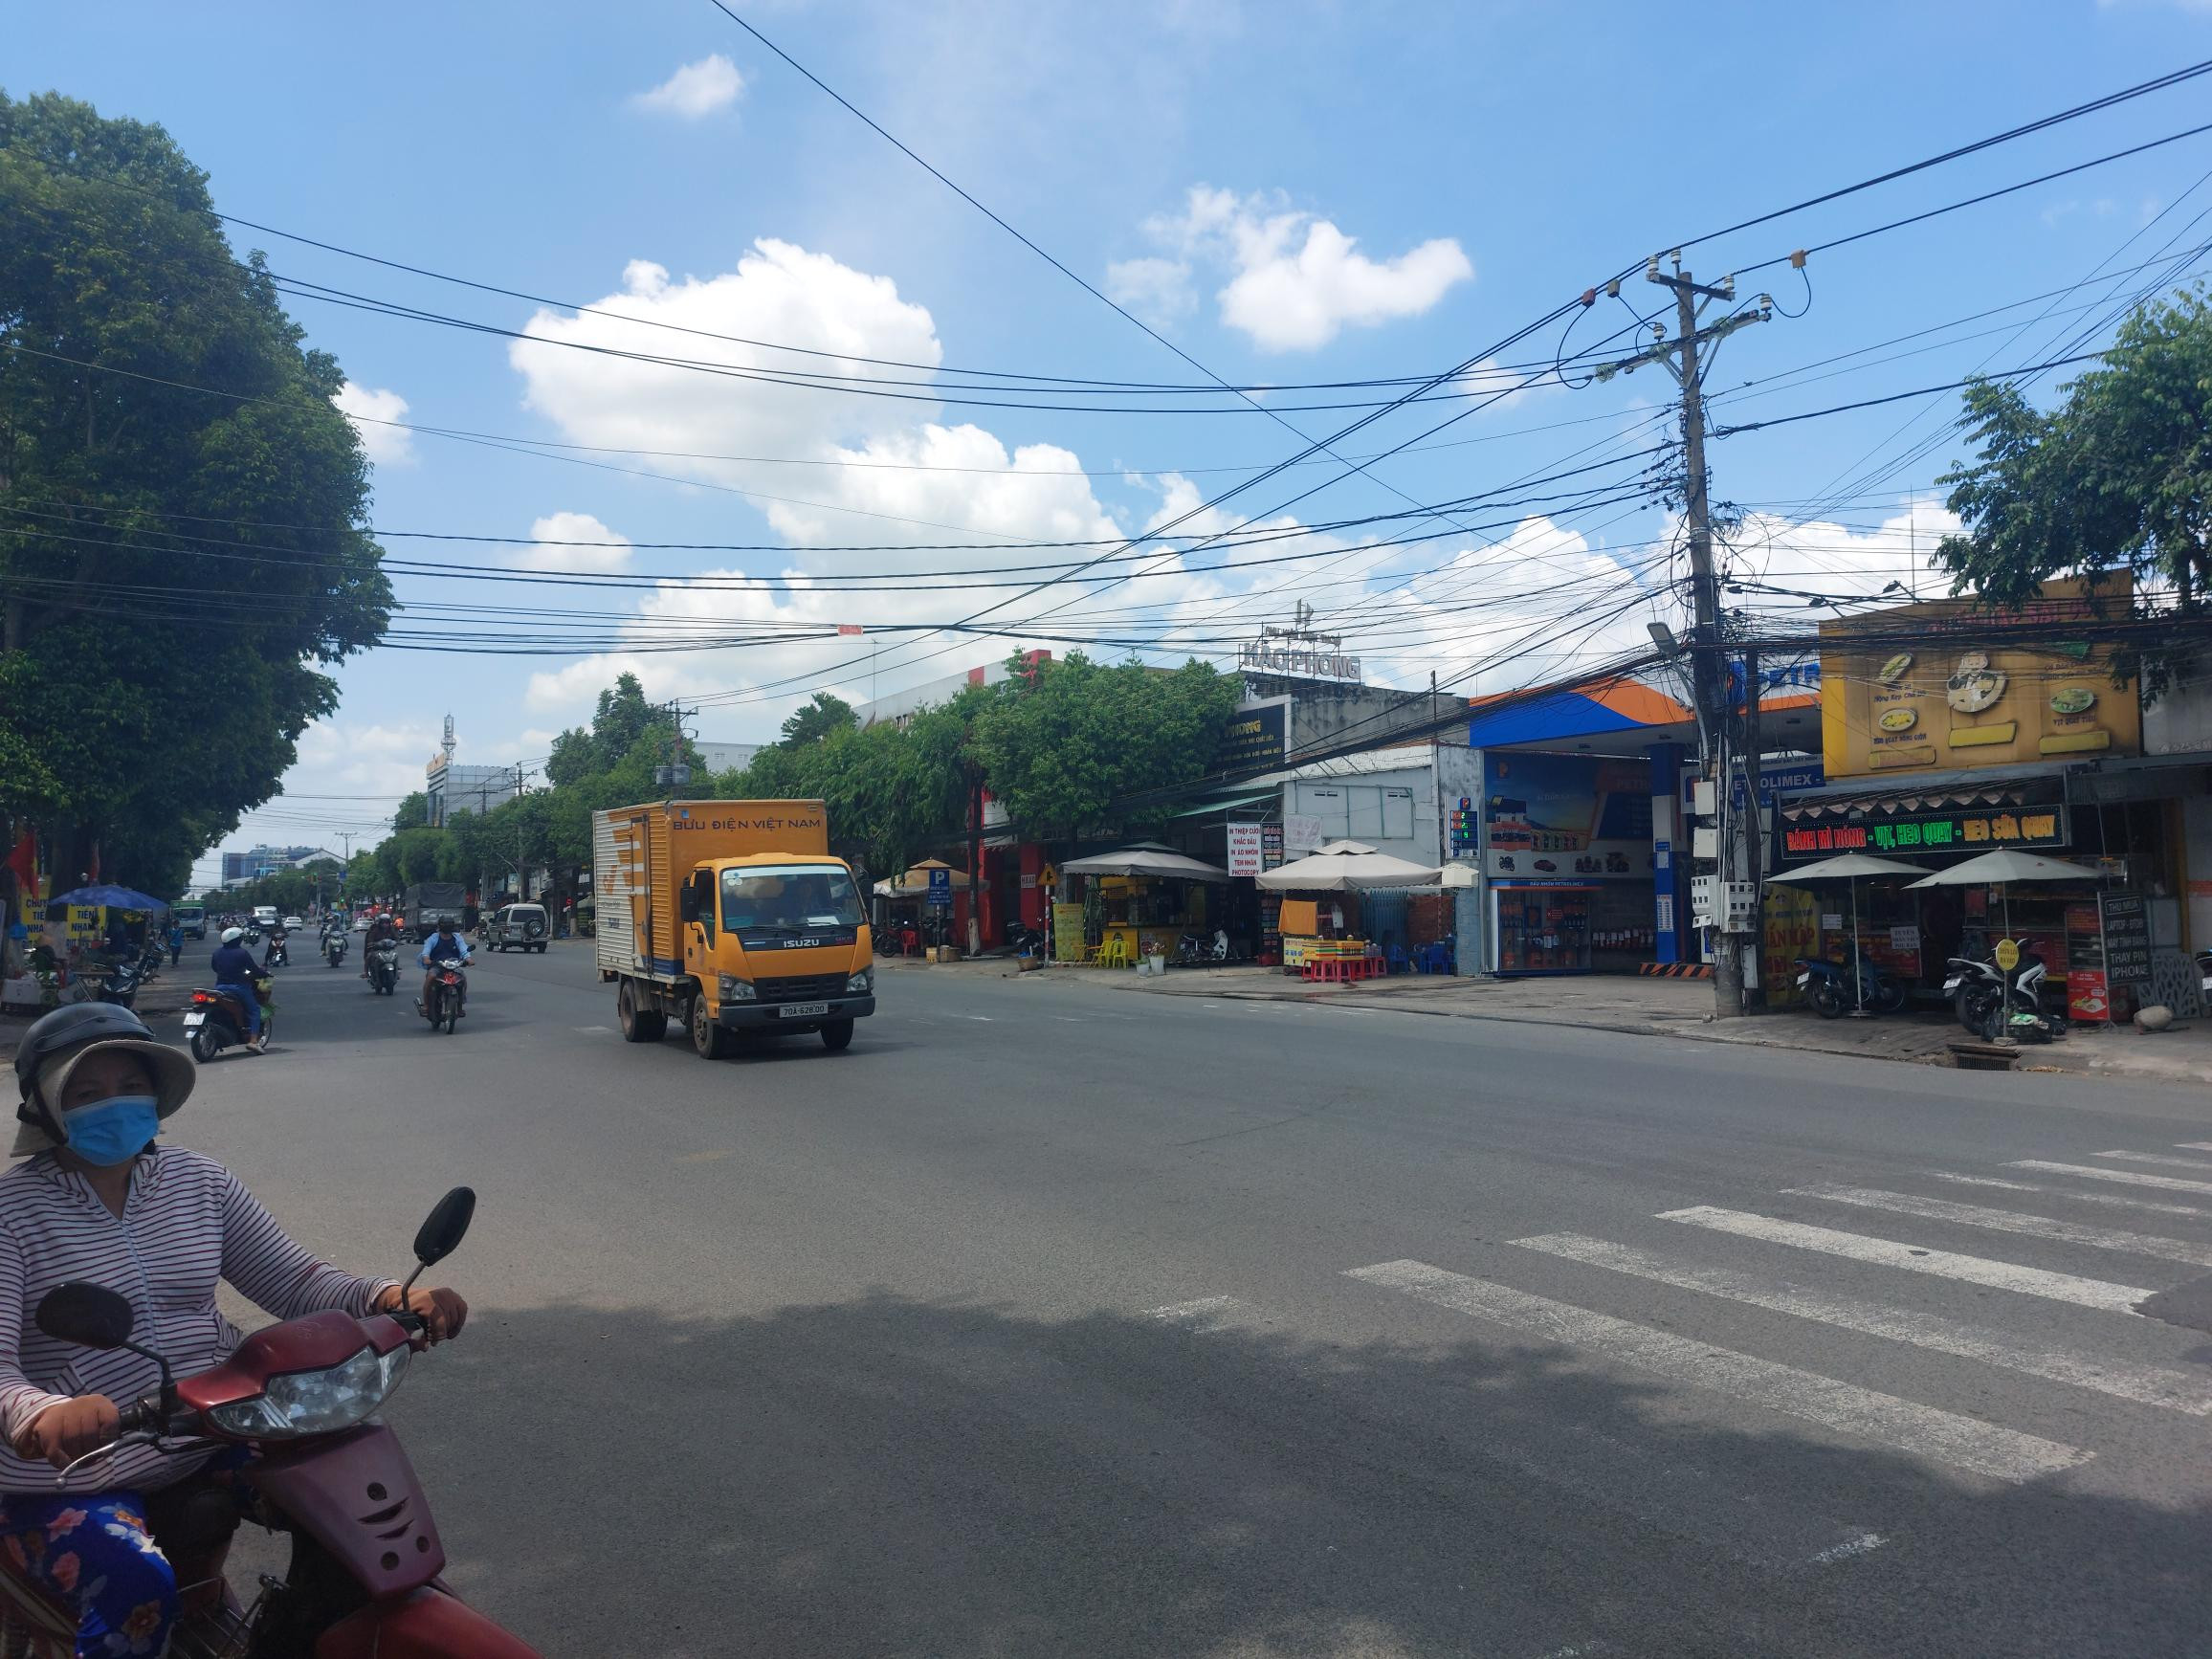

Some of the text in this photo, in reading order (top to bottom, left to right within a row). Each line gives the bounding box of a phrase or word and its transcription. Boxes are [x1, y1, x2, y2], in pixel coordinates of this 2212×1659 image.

[1292, 650, 1360, 679] PHONG
[1734, 774, 1812, 791] ETOLIMEX
[673, 816, 821, 832] BƯU ĐIỆN VIỆT NAM
[1235, 827, 1249, 835] THIỆP
[1786, 827, 1817, 852] BÁNH
[1818, 826, 1833, 849] MÌ
[1834, 825, 1867, 848] NÓNG
[1896, 824, 1921, 845] HEO
[1922, 821, 1952, 846] QUAY
[1963, 819, 1990, 841] HEO
[2021, 814, 2055, 840] QUAY
[935, 871, 945, 885] P
[2108, 902, 2121, 912] THU
[2107, 919, 2126, 932] LAPTOP
[784, 939, 820, 948] ISUZU
[2111, 950, 2148, 964] THAY PIN
[2111, 964, 2149, 979] IPHONE
